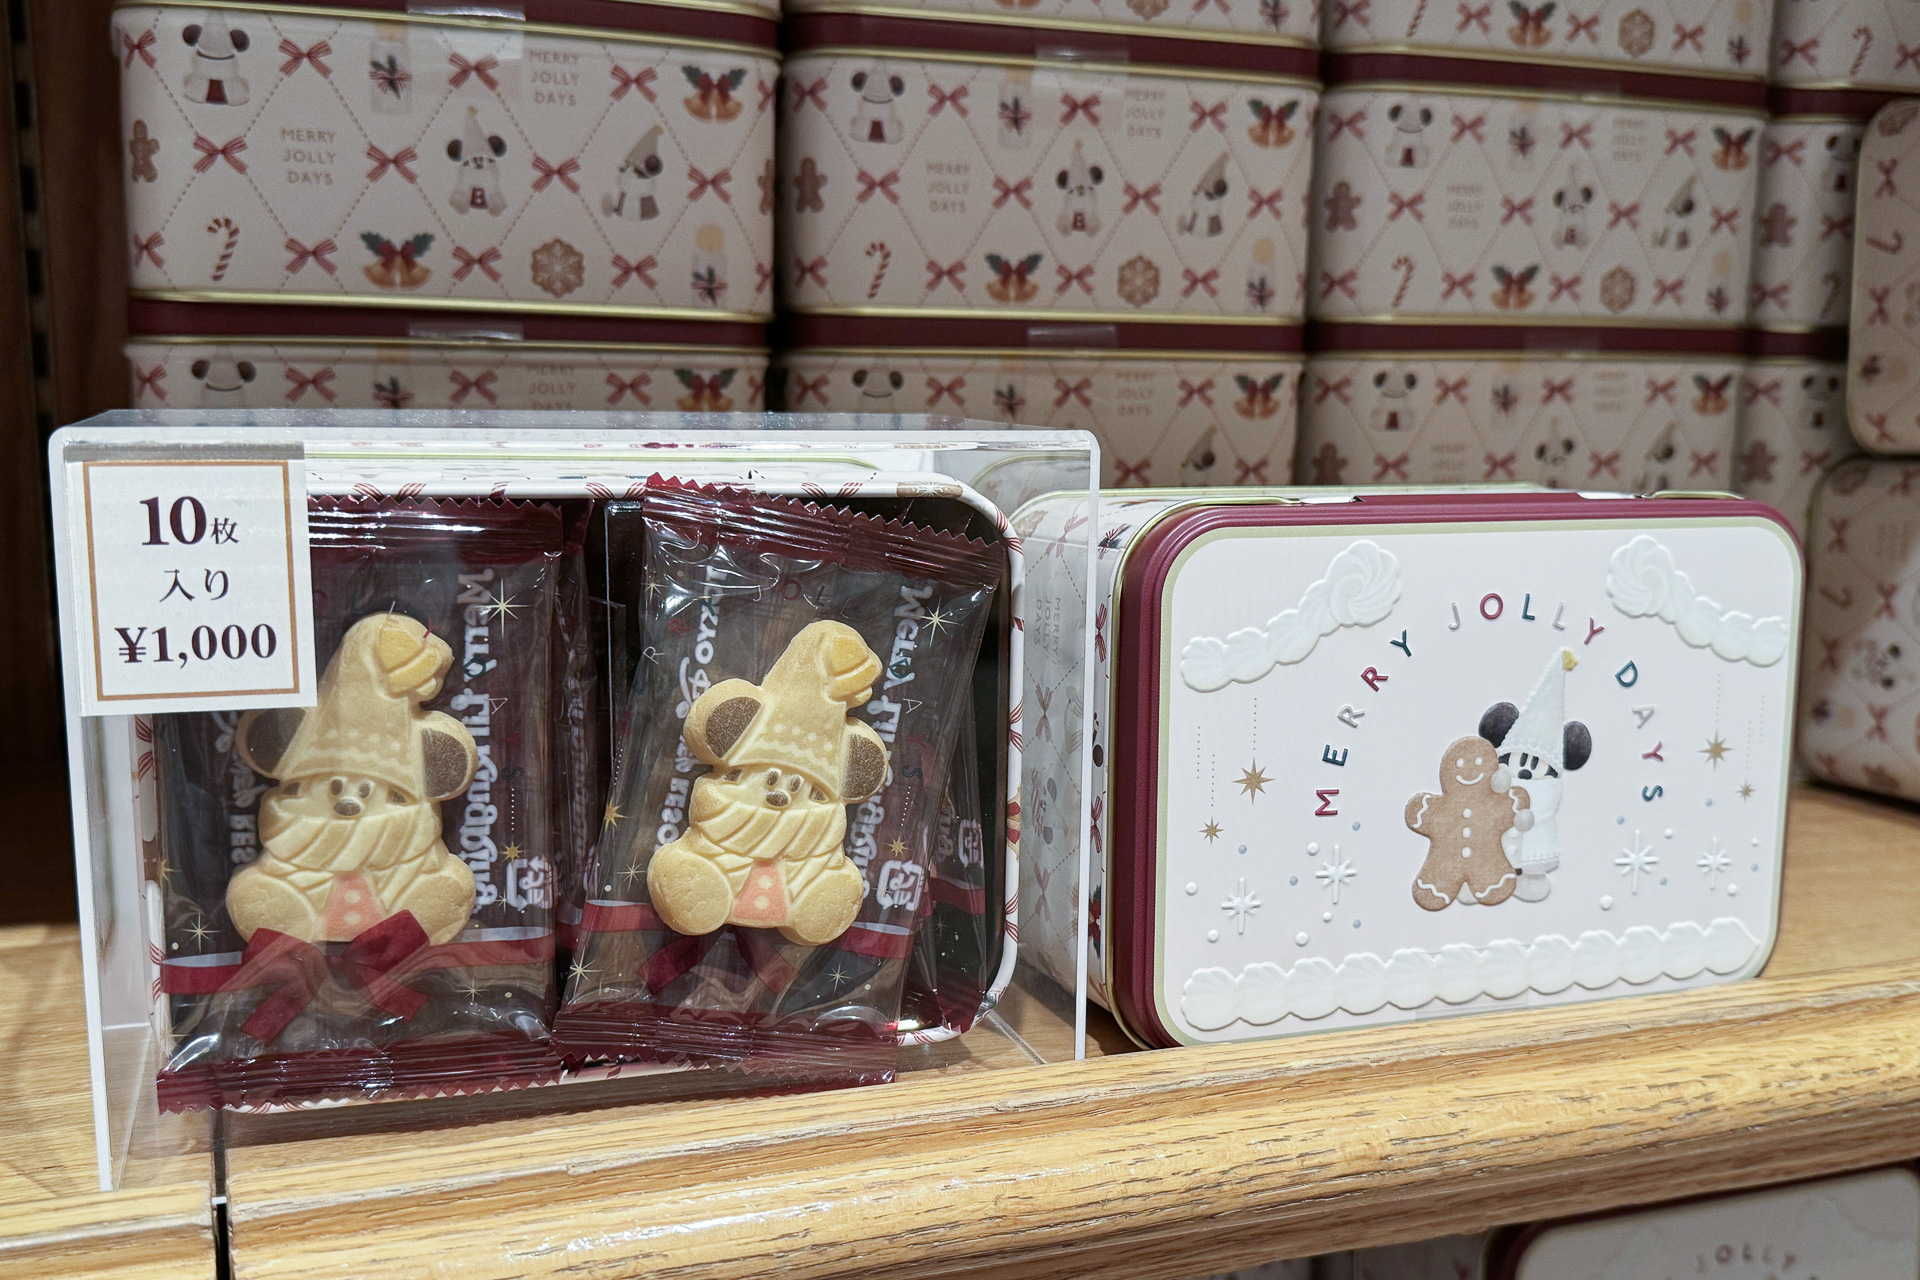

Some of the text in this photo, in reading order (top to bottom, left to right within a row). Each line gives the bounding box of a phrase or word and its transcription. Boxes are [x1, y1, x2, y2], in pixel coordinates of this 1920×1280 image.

[530, 71, 580, 86] JOLLY
[534, 91, 576, 107] DAYS
[281, 127, 337, 143] MERRY
[283, 149, 337, 164] JOLLY
[288, 170, 333, 186] DAYS
[140, 495, 240, 546] 10枚
[159, 568, 229, 602] 入り
[115, 623, 277, 669] ¥1,000
[1314, 592, 1664, 816] MERRY JOLLY DAYS
